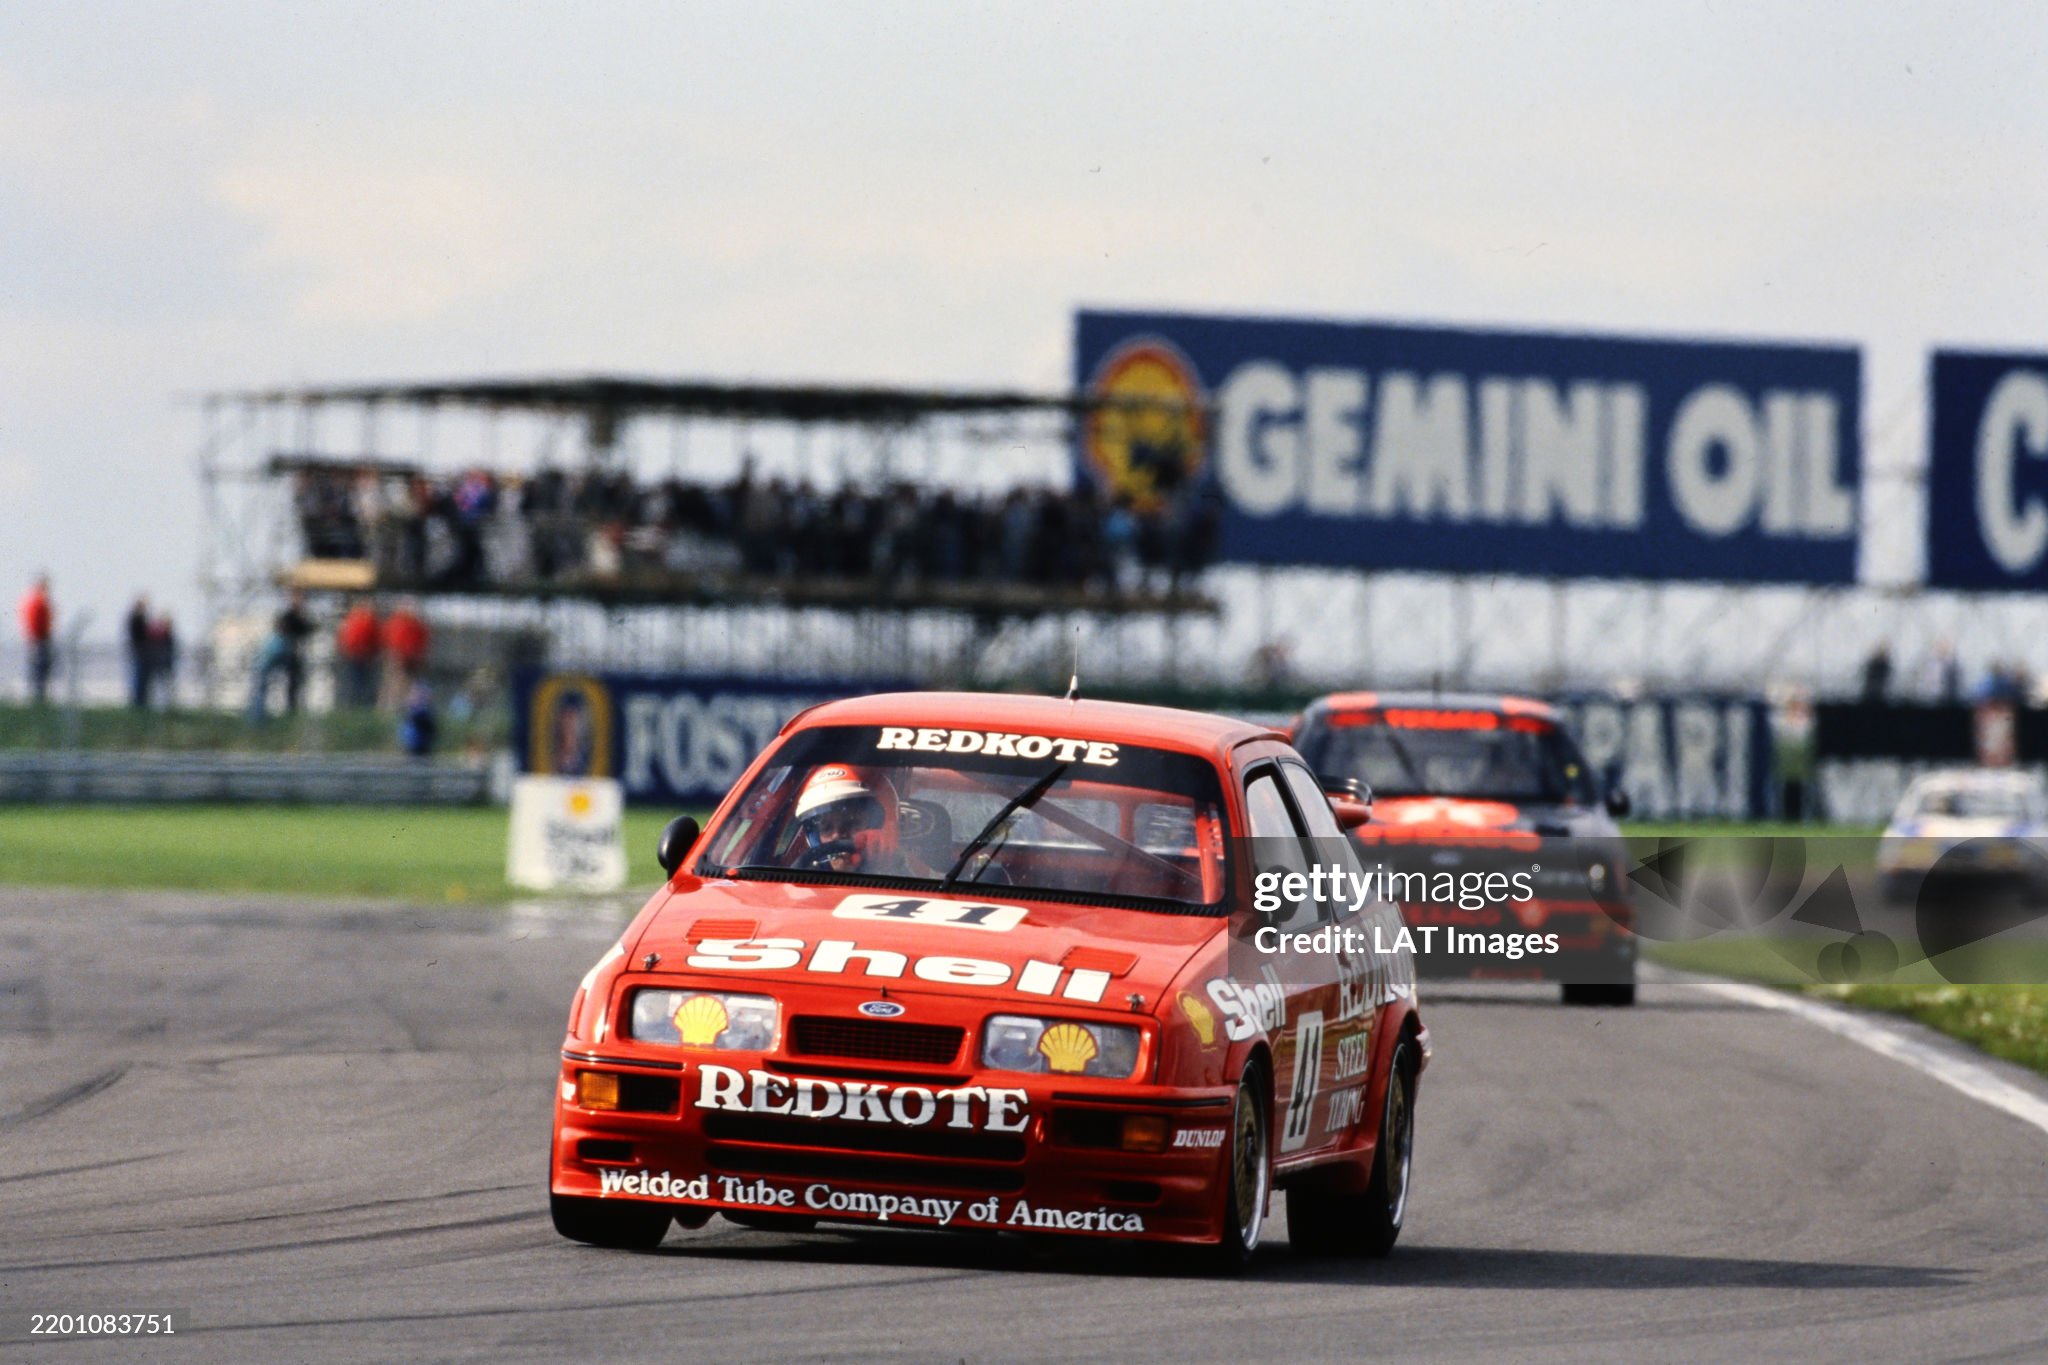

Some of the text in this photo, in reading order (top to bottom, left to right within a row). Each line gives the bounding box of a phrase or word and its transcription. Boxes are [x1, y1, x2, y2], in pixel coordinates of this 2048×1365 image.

[1218, 358, 1854, 538] GEMINI OIL
[876, 727, 1120, 767] REDKOTE
[862, 899, 996, 925] 41
[686, 938, 1112, 1003] Shell
[1206, 963, 1286, 1041] Shell
[1335, 1031, 1368, 1080] STEEL
[694, 1064, 1031, 1133] REDKOTE
[1172, 1129, 1226, 1148] DUNLOP
[598, 1168, 1145, 1232] Welded Tube Company of America
